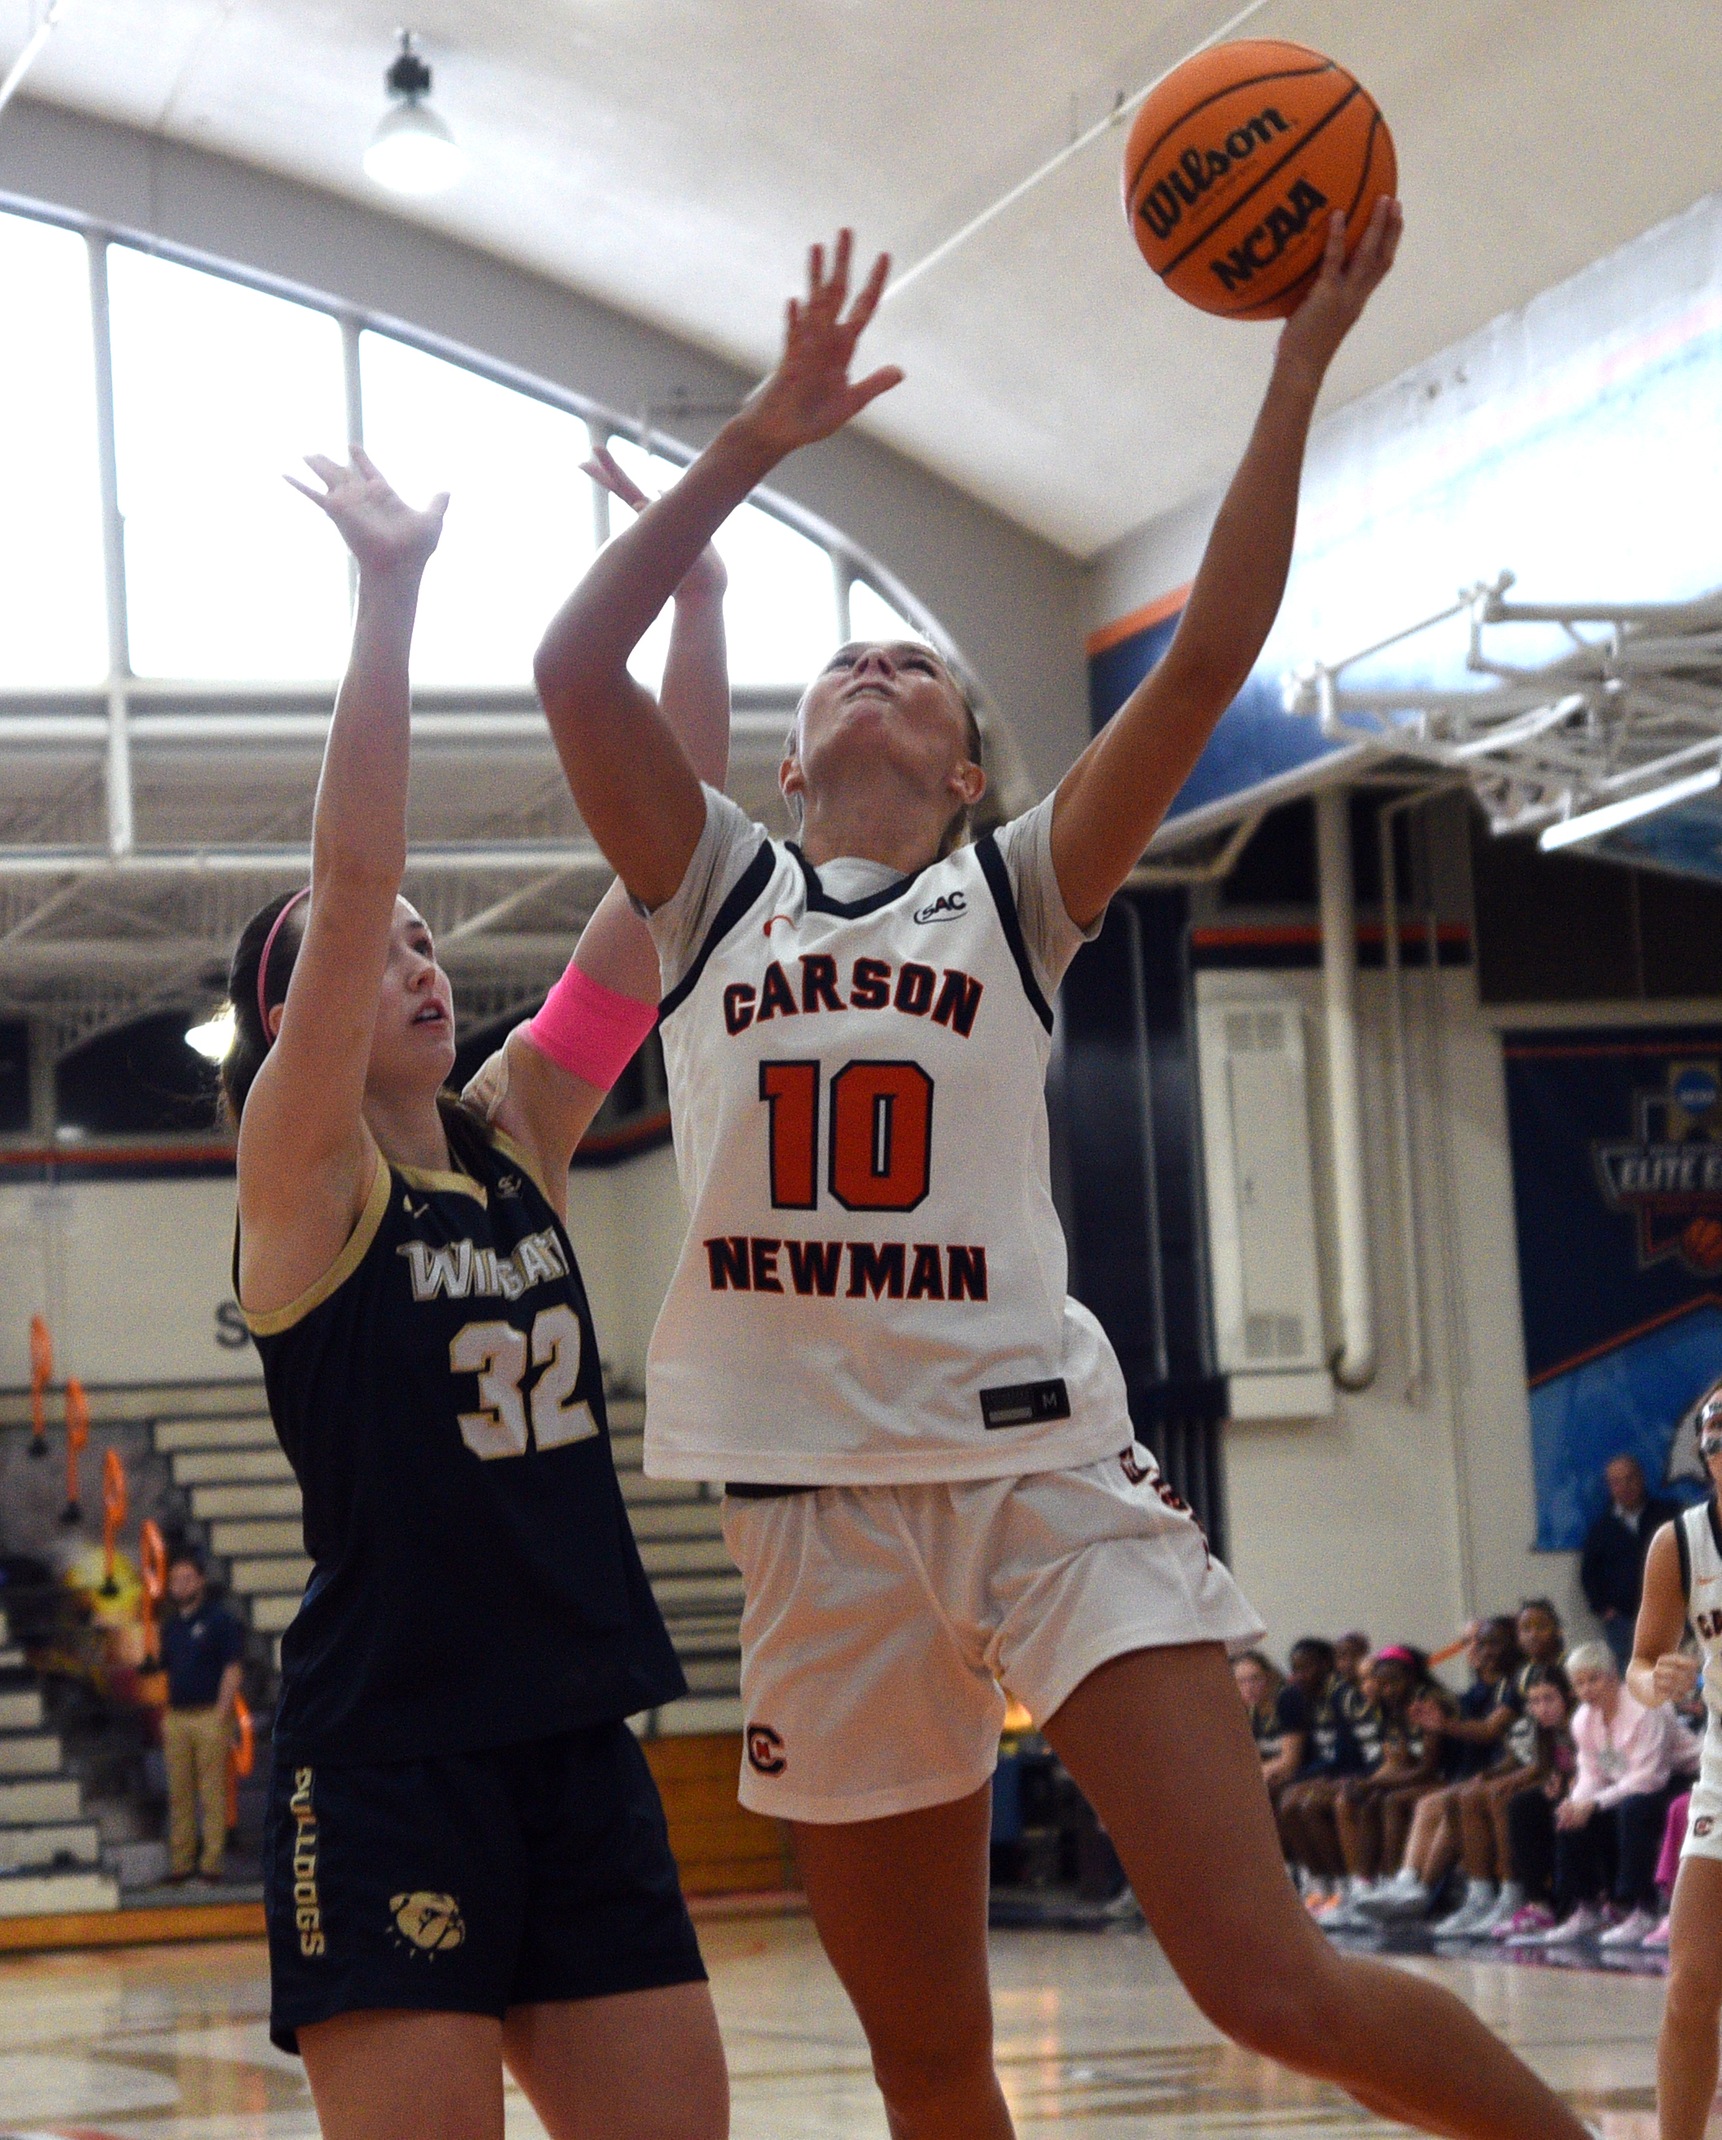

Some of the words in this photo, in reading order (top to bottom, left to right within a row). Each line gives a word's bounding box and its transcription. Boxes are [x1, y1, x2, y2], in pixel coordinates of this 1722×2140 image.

[1139, 107, 1289, 239] Wilson
[1210, 178, 1327, 291] NCAA
[723, 954, 984, 1038] CARSON
[759, 1059, 934, 1212] 10
[704, 1236, 988, 1302] NEWMAN
[449, 1304, 599, 1462] 32
